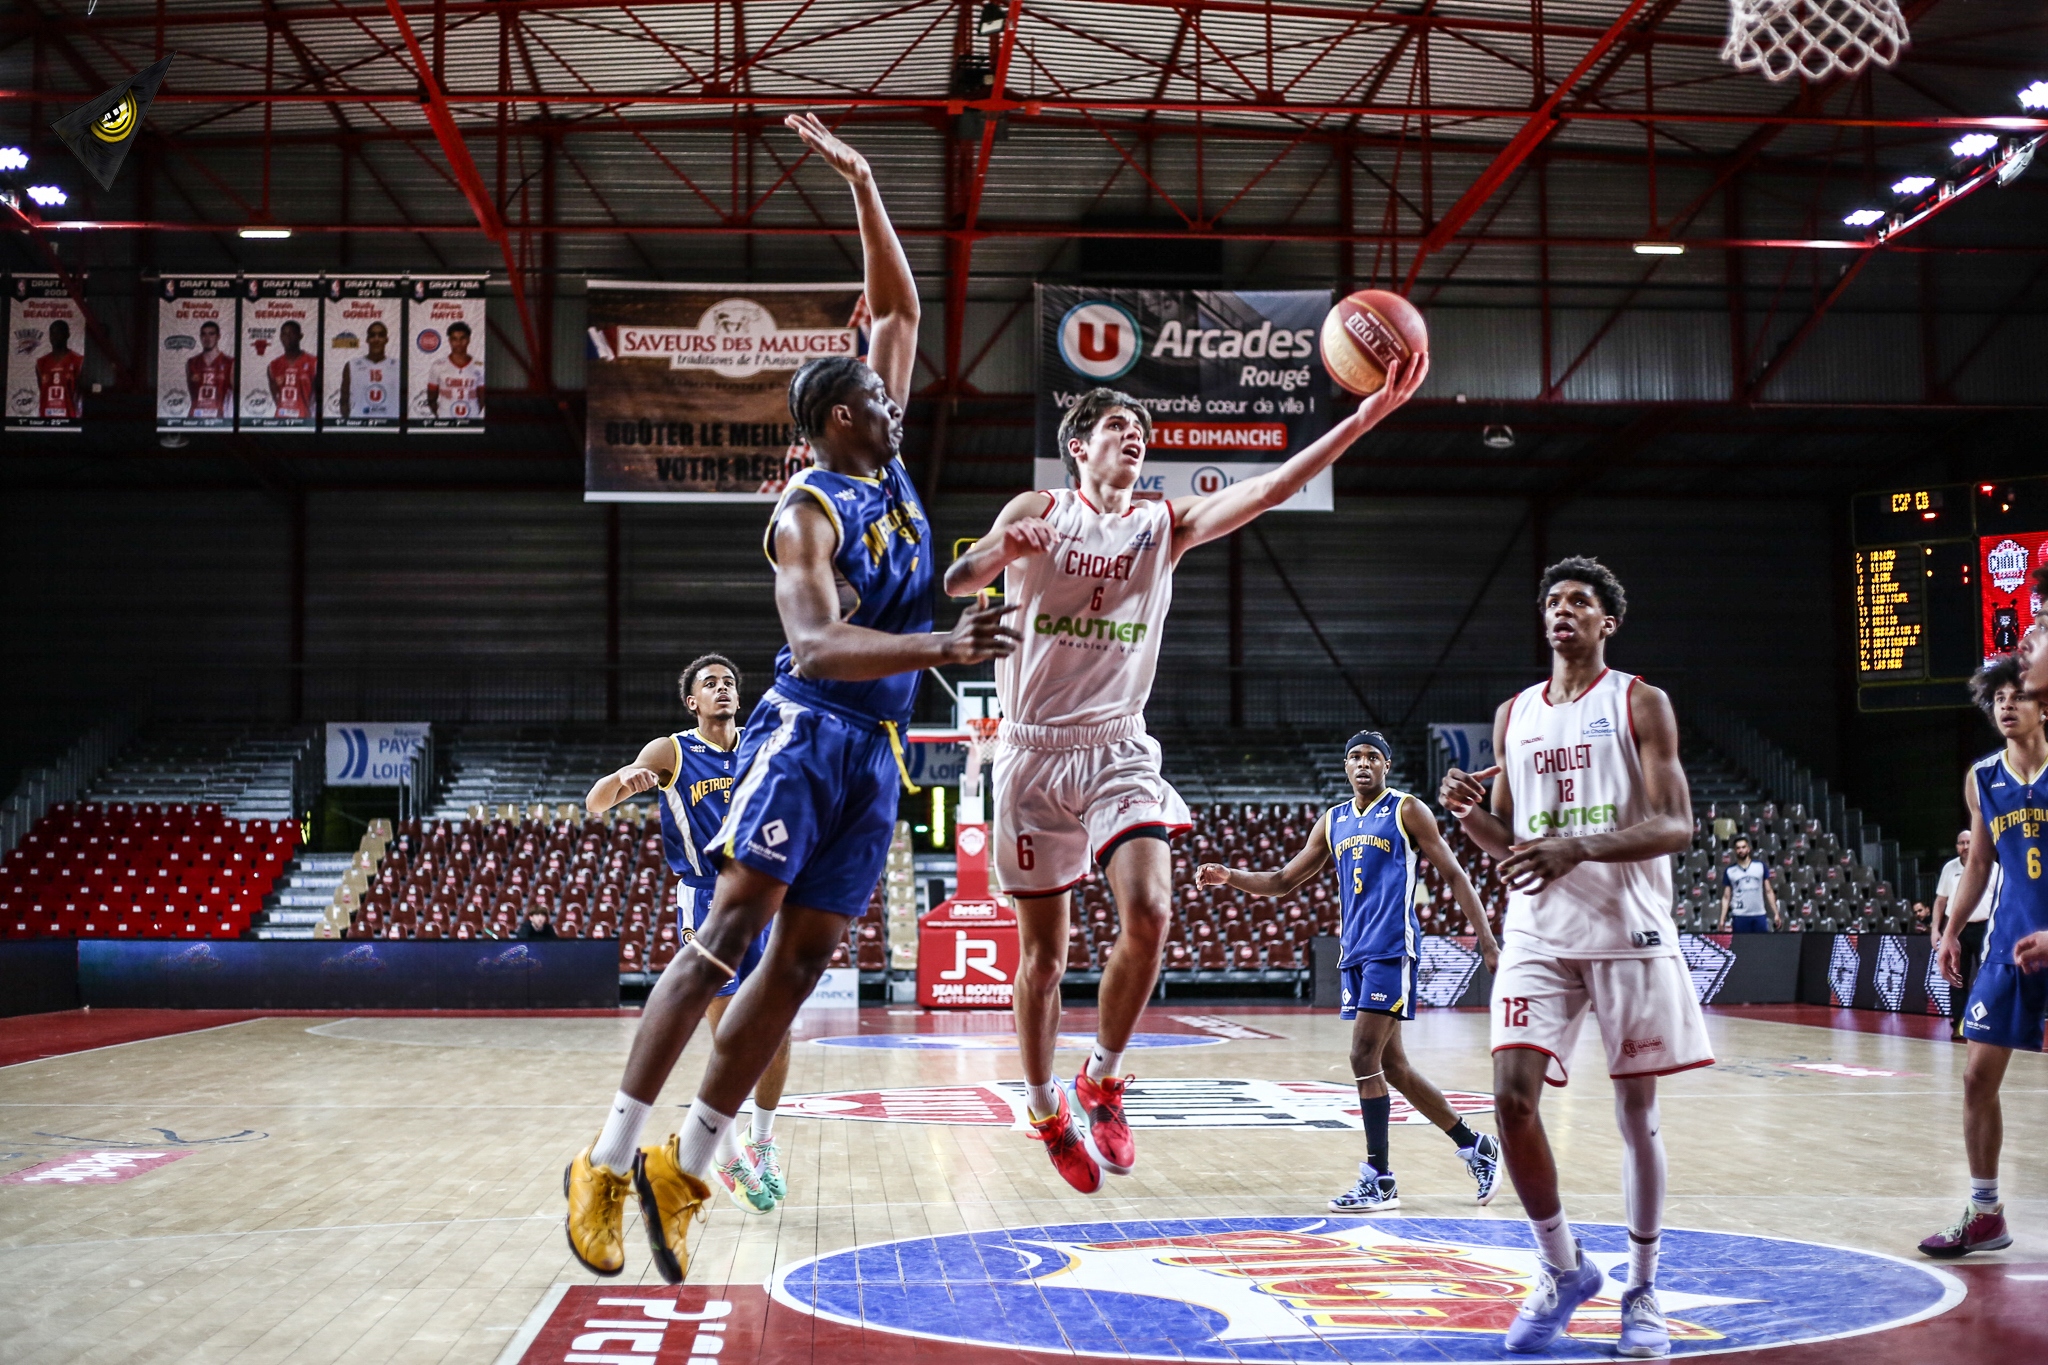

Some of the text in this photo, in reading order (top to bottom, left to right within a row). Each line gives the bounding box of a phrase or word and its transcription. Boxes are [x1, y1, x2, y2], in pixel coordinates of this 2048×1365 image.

[31, 280, 62, 288] DRAFT
[180, 280, 230, 288] DRAFT NBA
[262, 280, 290, 288] DRAFT
[375, 281, 395, 289] NBA
[429, 281, 479, 289] DRAFT NBA
[276, 289, 300, 297] 2010
[442, 289, 466, 298] 2020
[28, 301, 68, 311] Rodrigue
[23, 311, 73, 319] BEAUBOIS
[176, 311, 219, 319] DE COLO
[255, 311, 306, 319] SERAPHIN
[343, 311, 383, 319] GOBERT
[430, 311, 464, 320] HAYES
[625, 331, 851, 352] SAVEURS DES MAUGES
[1078, 322, 1120, 363] U
[1151, 320, 1314, 359] Arcades
[677, 353, 733, 366] traditions
[736, 355, 750, 366] de
[1240, 364, 1311, 391] Rougé
[1206, 399, 1248, 414] cœur
[1253, 397, 1274, 413] de
[1279, 397, 1305, 414] ville
[1309, 396, 1315, 413] !
[605, 418, 694, 446] GOÛTER
[700, 423, 723, 446] LE
[1163, 428, 1184, 445] LE
[1188, 428, 1283, 446] DIMANCHE
[656, 456, 730, 482] VOTRE
[1200, 475, 1218, 493] U
[1065, 550, 1134, 581] CHOLET
[1090, 586, 1105, 612] 6
[1033, 613, 1148, 643] GAUTIER
[1533, 744, 1593, 775] CHOLET
[372, 763, 412, 780] LOIR
[1556, 778, 1575, 804] 12
[1527, 803, 1619, 834] GAUTIER
[2022, 822, 2040, 838] 92
[1016, 834, 1035, 871] 6
[1352, 846, 1363, 860] 92
[2026, 847, 2042, 879] 6
[1353, 867, 1363, 894] 5
[932, 984, 1014, 998] JEAN ROUYER
[937, 996, 1011, 1004] AUTOMOBILES
[1503, 997, 1529, 1028] 12
